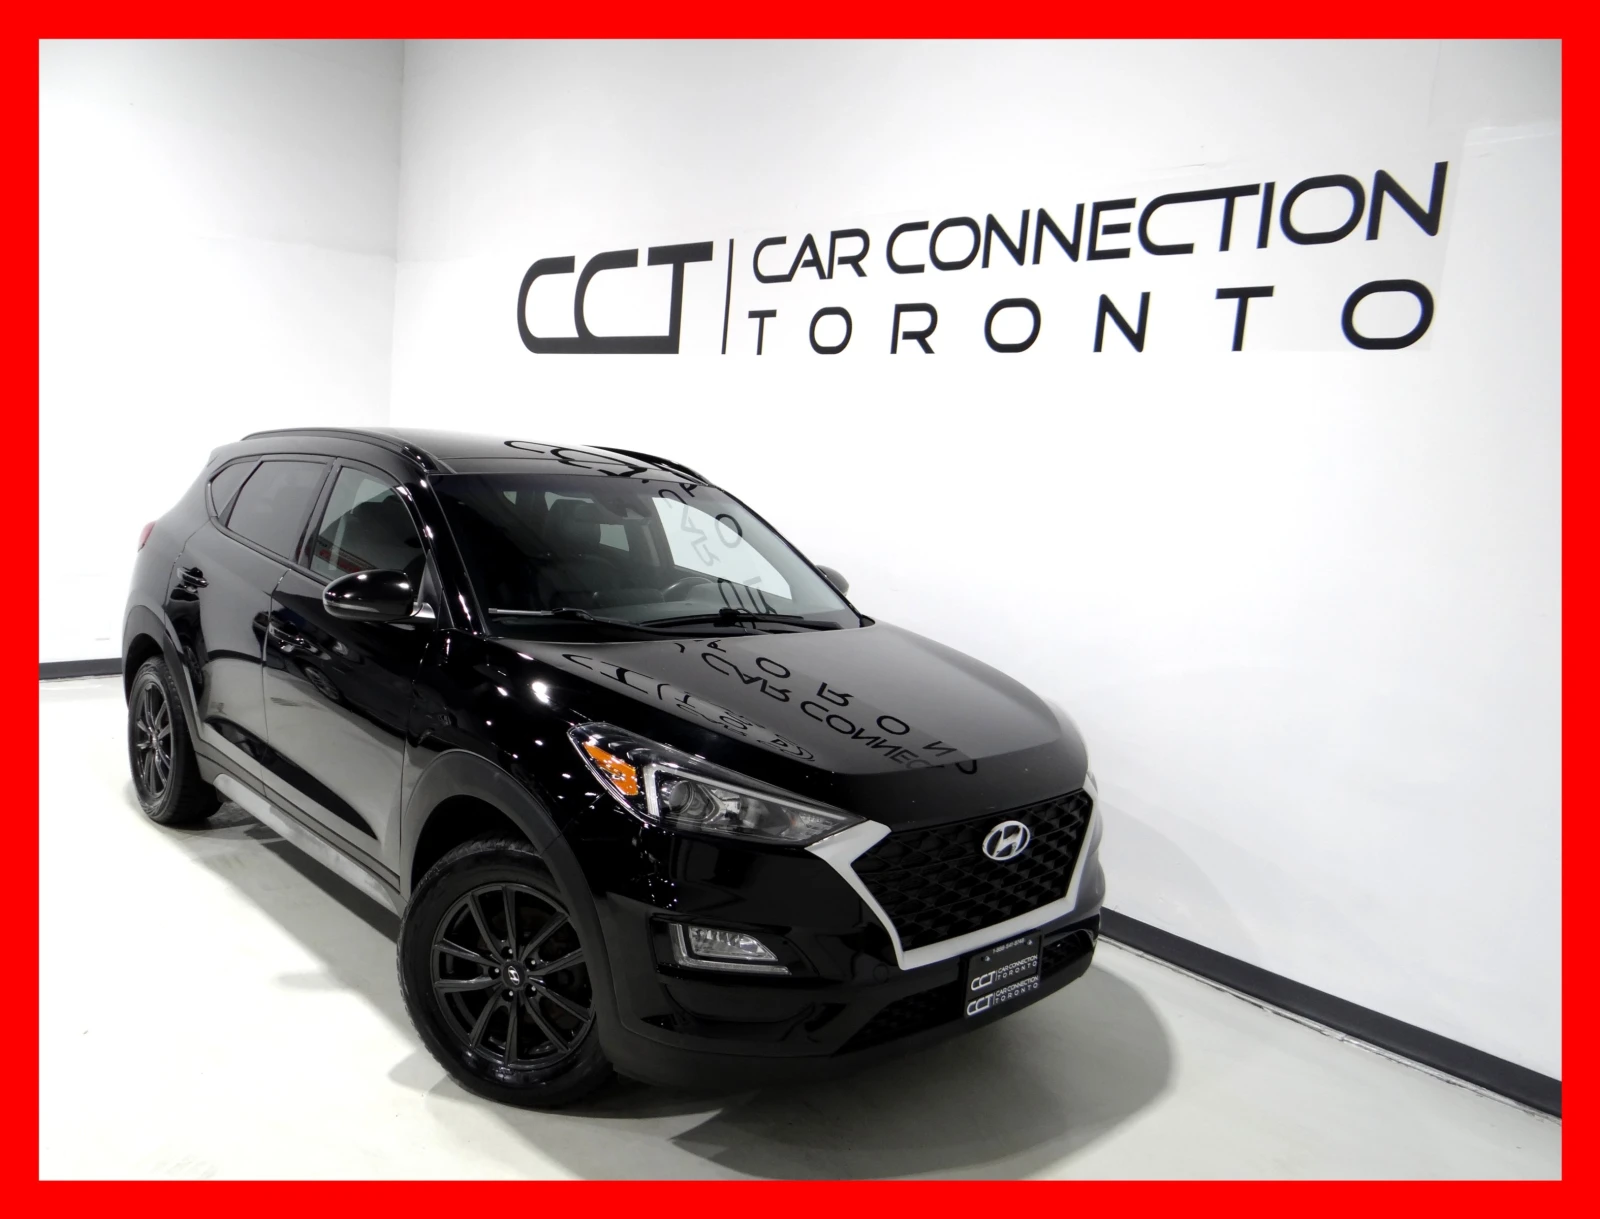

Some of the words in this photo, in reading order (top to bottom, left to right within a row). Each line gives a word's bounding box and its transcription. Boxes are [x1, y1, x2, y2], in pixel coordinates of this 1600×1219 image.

[753, 228, 870, 284] CAR
[886, 161, 1449, 274] CONNECTION
[518, 241, 714, 355] CCT
[748, 279, 1434, 356] TORONTO
[997, 965, 1009, 973] CAR
[1008, 954, 1038, 969] CONNECTION
[997, 960, 1037, 980] TORONTO
[970, 970, 996, 991] CCT
[995, 987, 1007, 997] CAR
[1006, 975, 1039, 992] CONNECTION
[995, 982, 1039, 1004] TORONTO
[966, 993, 994, 1016] CCT
